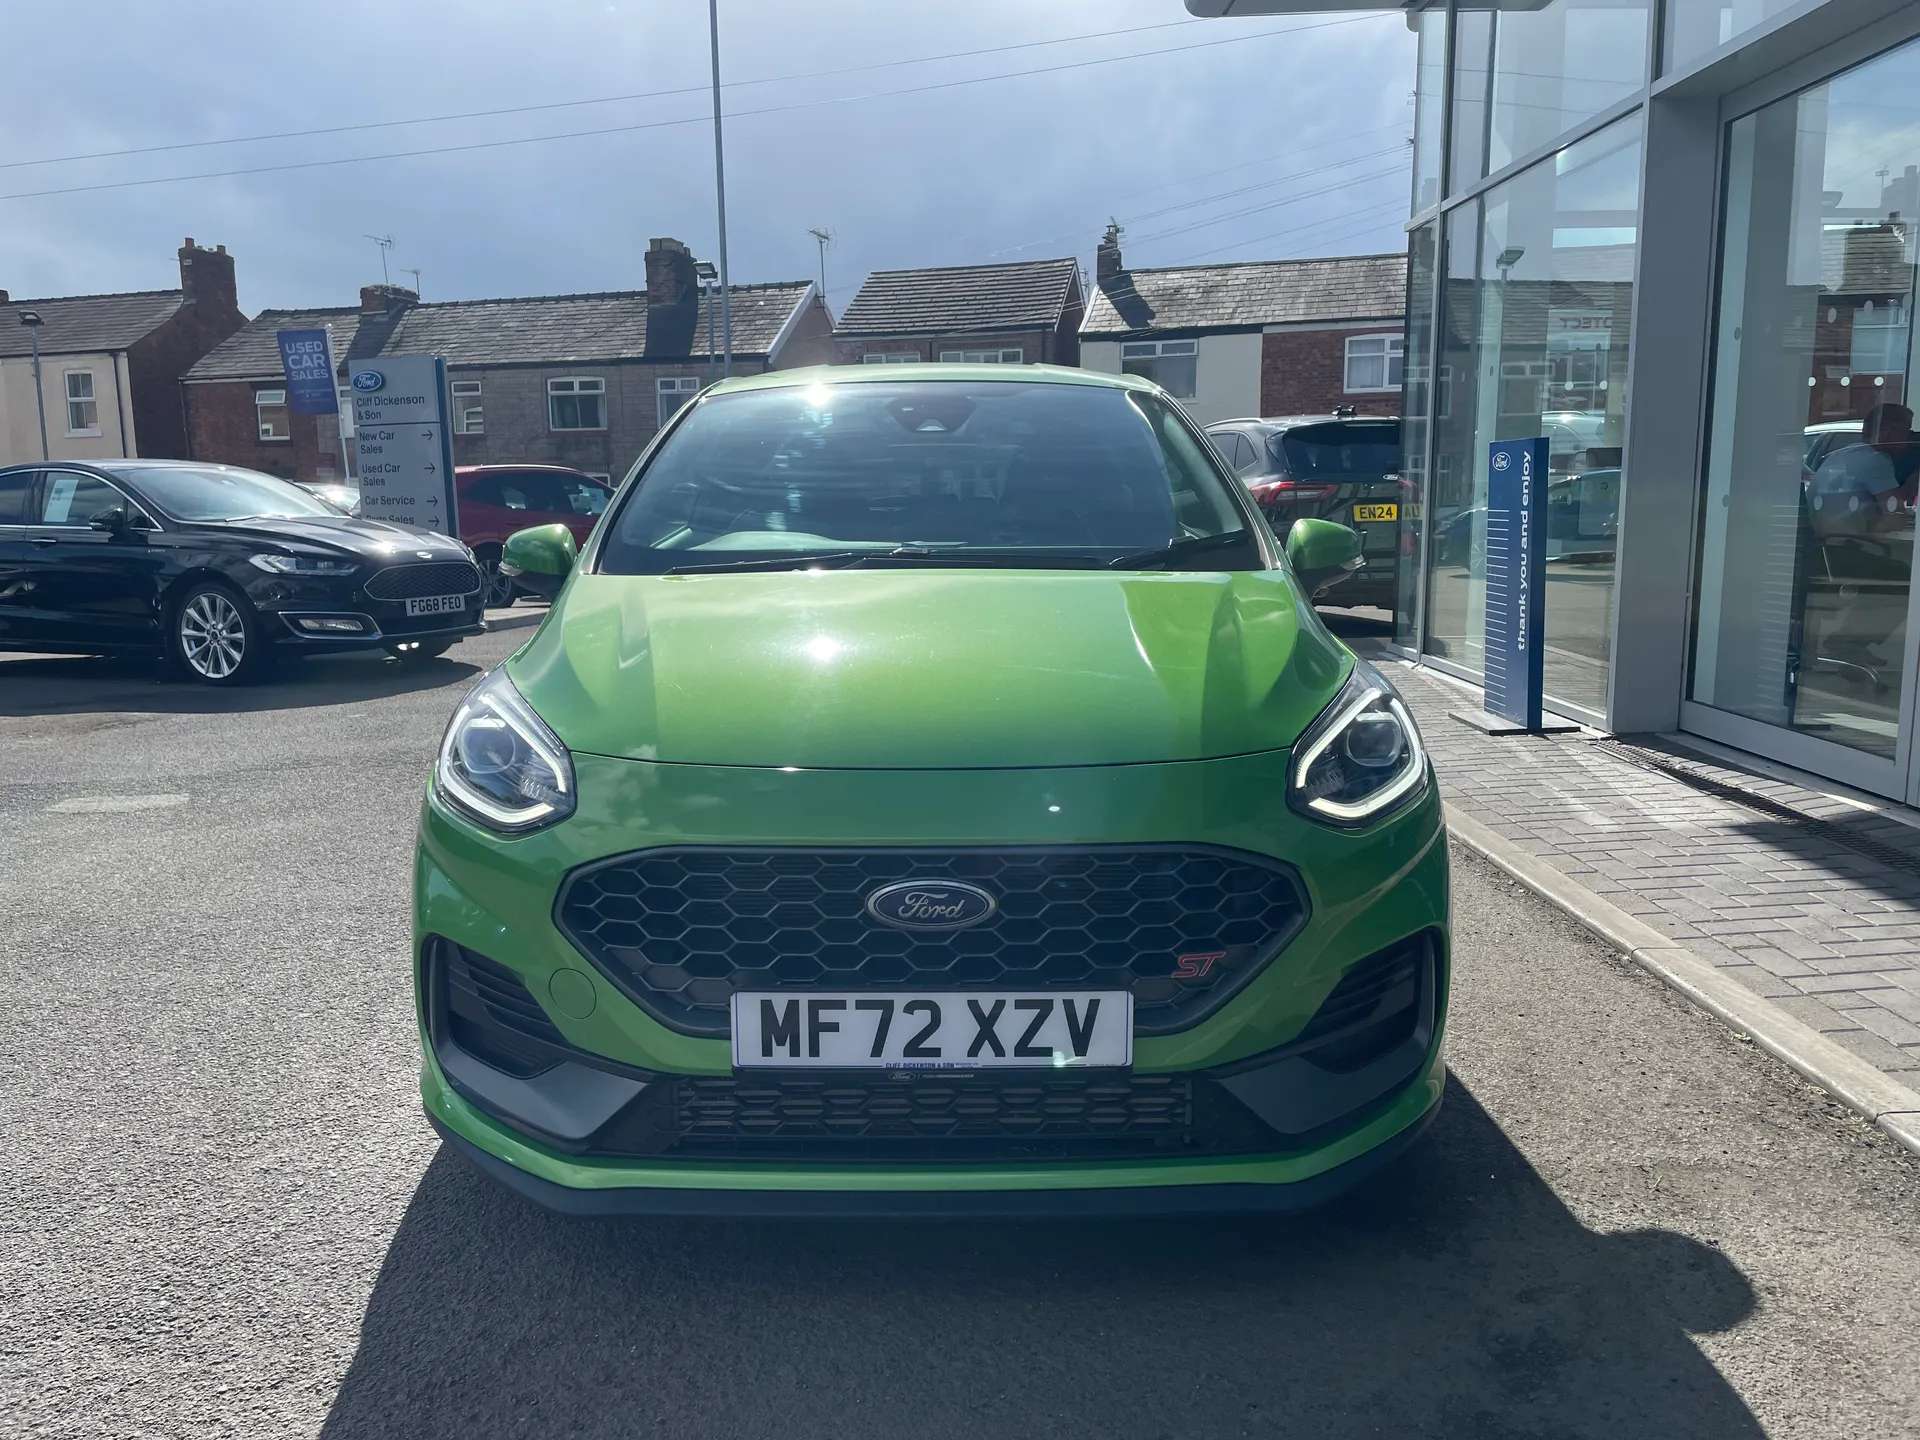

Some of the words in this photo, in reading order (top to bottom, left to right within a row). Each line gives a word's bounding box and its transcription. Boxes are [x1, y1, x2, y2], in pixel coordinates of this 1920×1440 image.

[285, 341, 323, 353] USED
[288, 353, 325, 369] CAR
[291, 369, 329, 380] SALES
[358, 411, 364, 420] &
[365, 410, 382, 420] Son
[360, 431, 378, 441] New
[379, 430, 395, 441] Car
[360, 444, 383, 455] Sales
[362, 464, 383, 473] Used
[384, 463, 400, 473] Car
[363, 477, 386, 487] Sales
[1522, 451, 1532, 507] enjoy
[365, 496, 379, 505] Car
[380, 495, 415, 505] Service
[1359, 506, 1395, 519] EN24
[388, 514, 415, 525] Sales
[1521, 510, 1529, 550] and
[1520, 553, 1528, 590] you
[410, 598, 439, 613] FG68
[441, 596, 461, 610] FEO
[1518, 592, 1527, 651] thank
[898, 891, 967, 919] Ford
[1172, 951, 1227, 979] ST
[760, 998, 942, 1058] MF72
[966, 998, 1102, 1058] XZV
